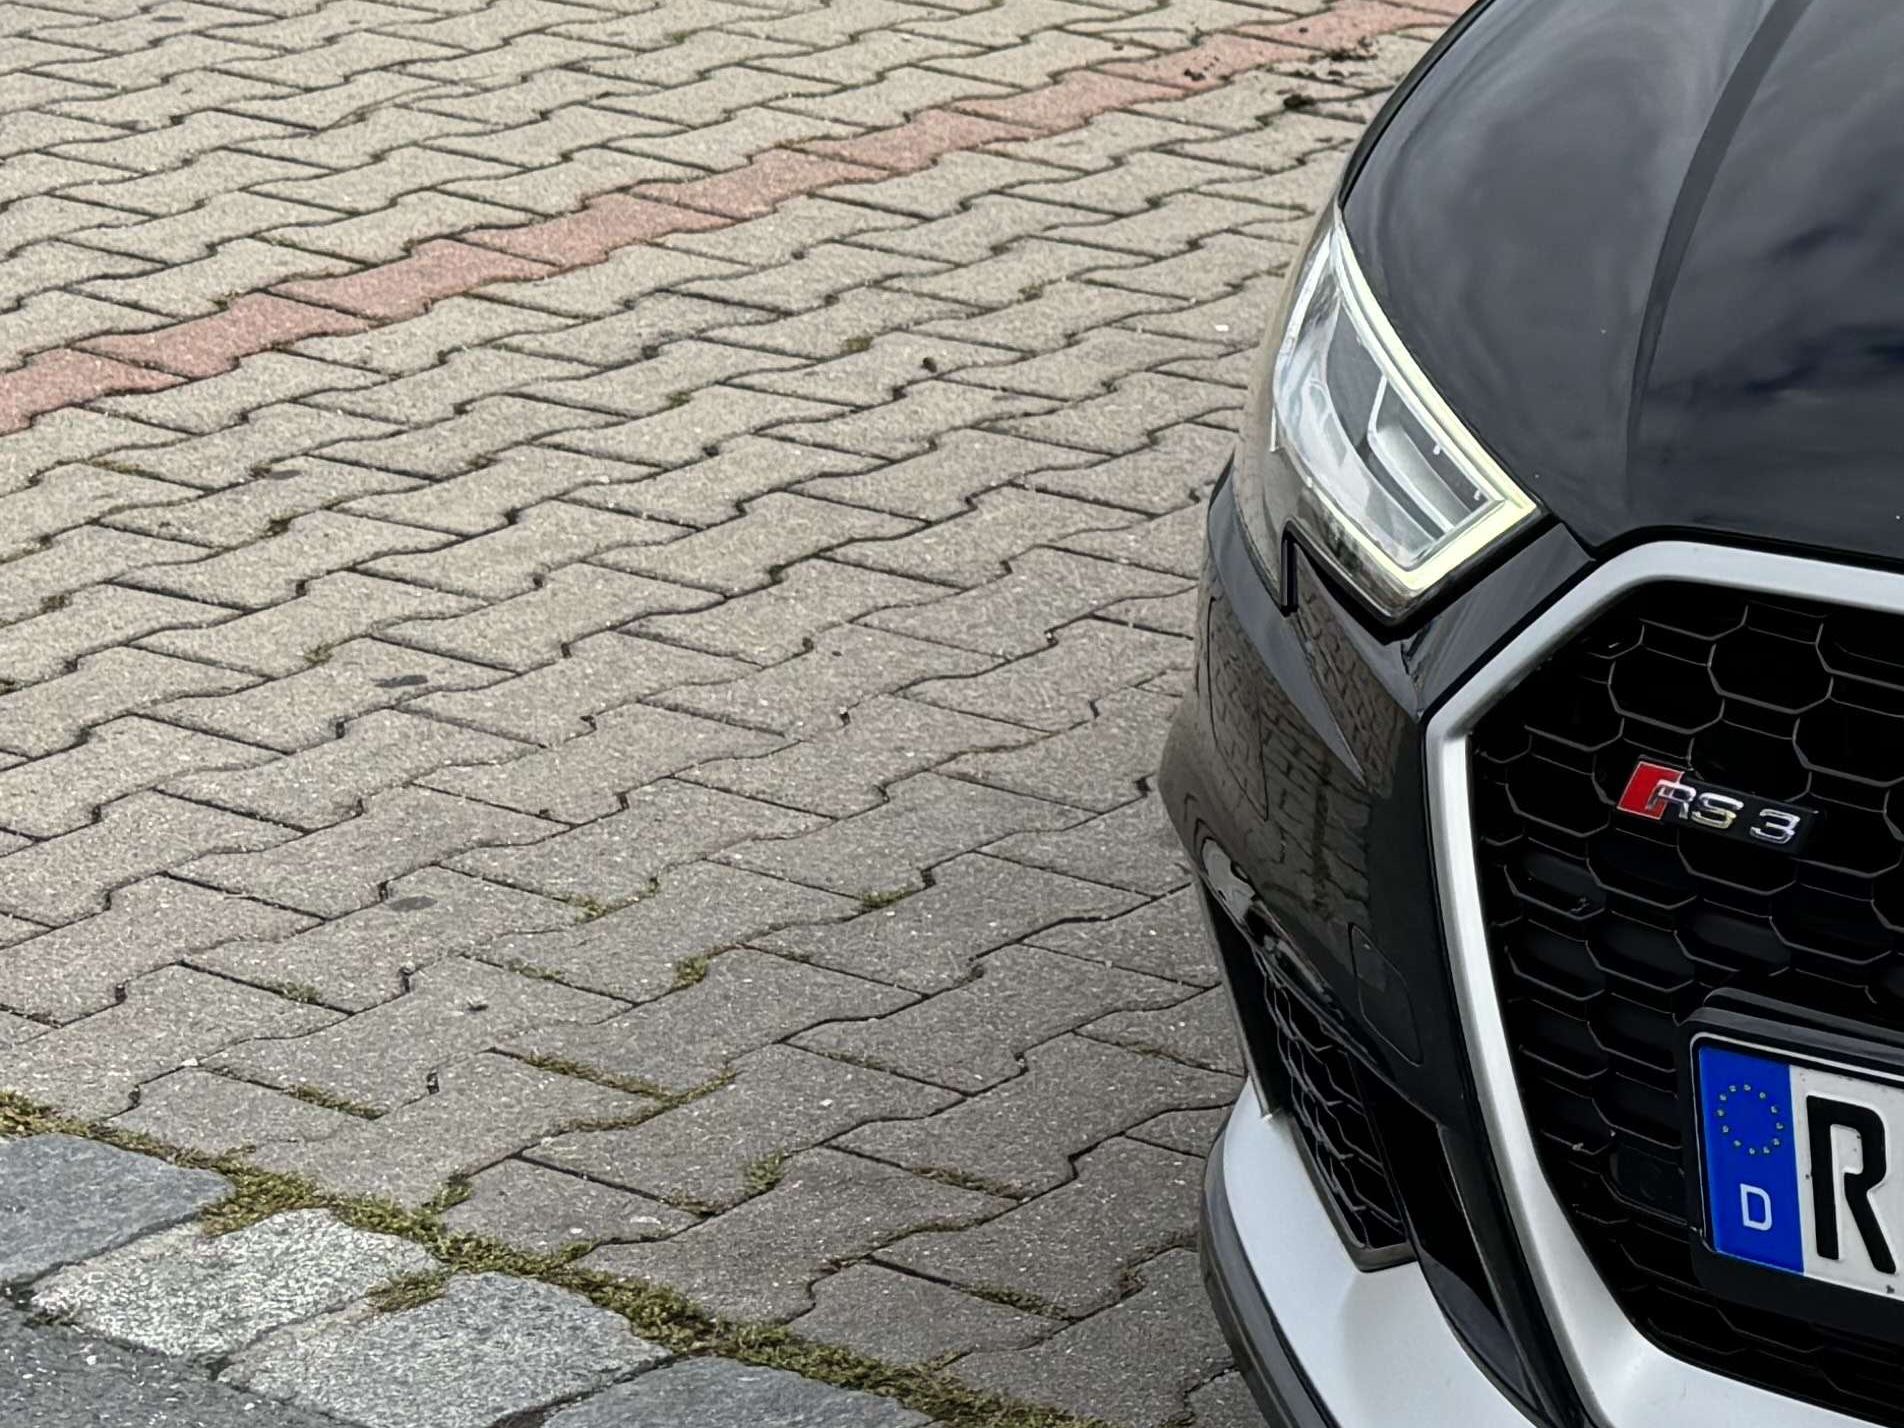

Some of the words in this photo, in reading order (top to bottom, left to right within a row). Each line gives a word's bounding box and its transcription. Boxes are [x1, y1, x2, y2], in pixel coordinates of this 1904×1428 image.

[1644, 778, 1744, 830] RS
[1749, 807, 1801, 845] 3
[1740, 1183, 1773, 1231] D
